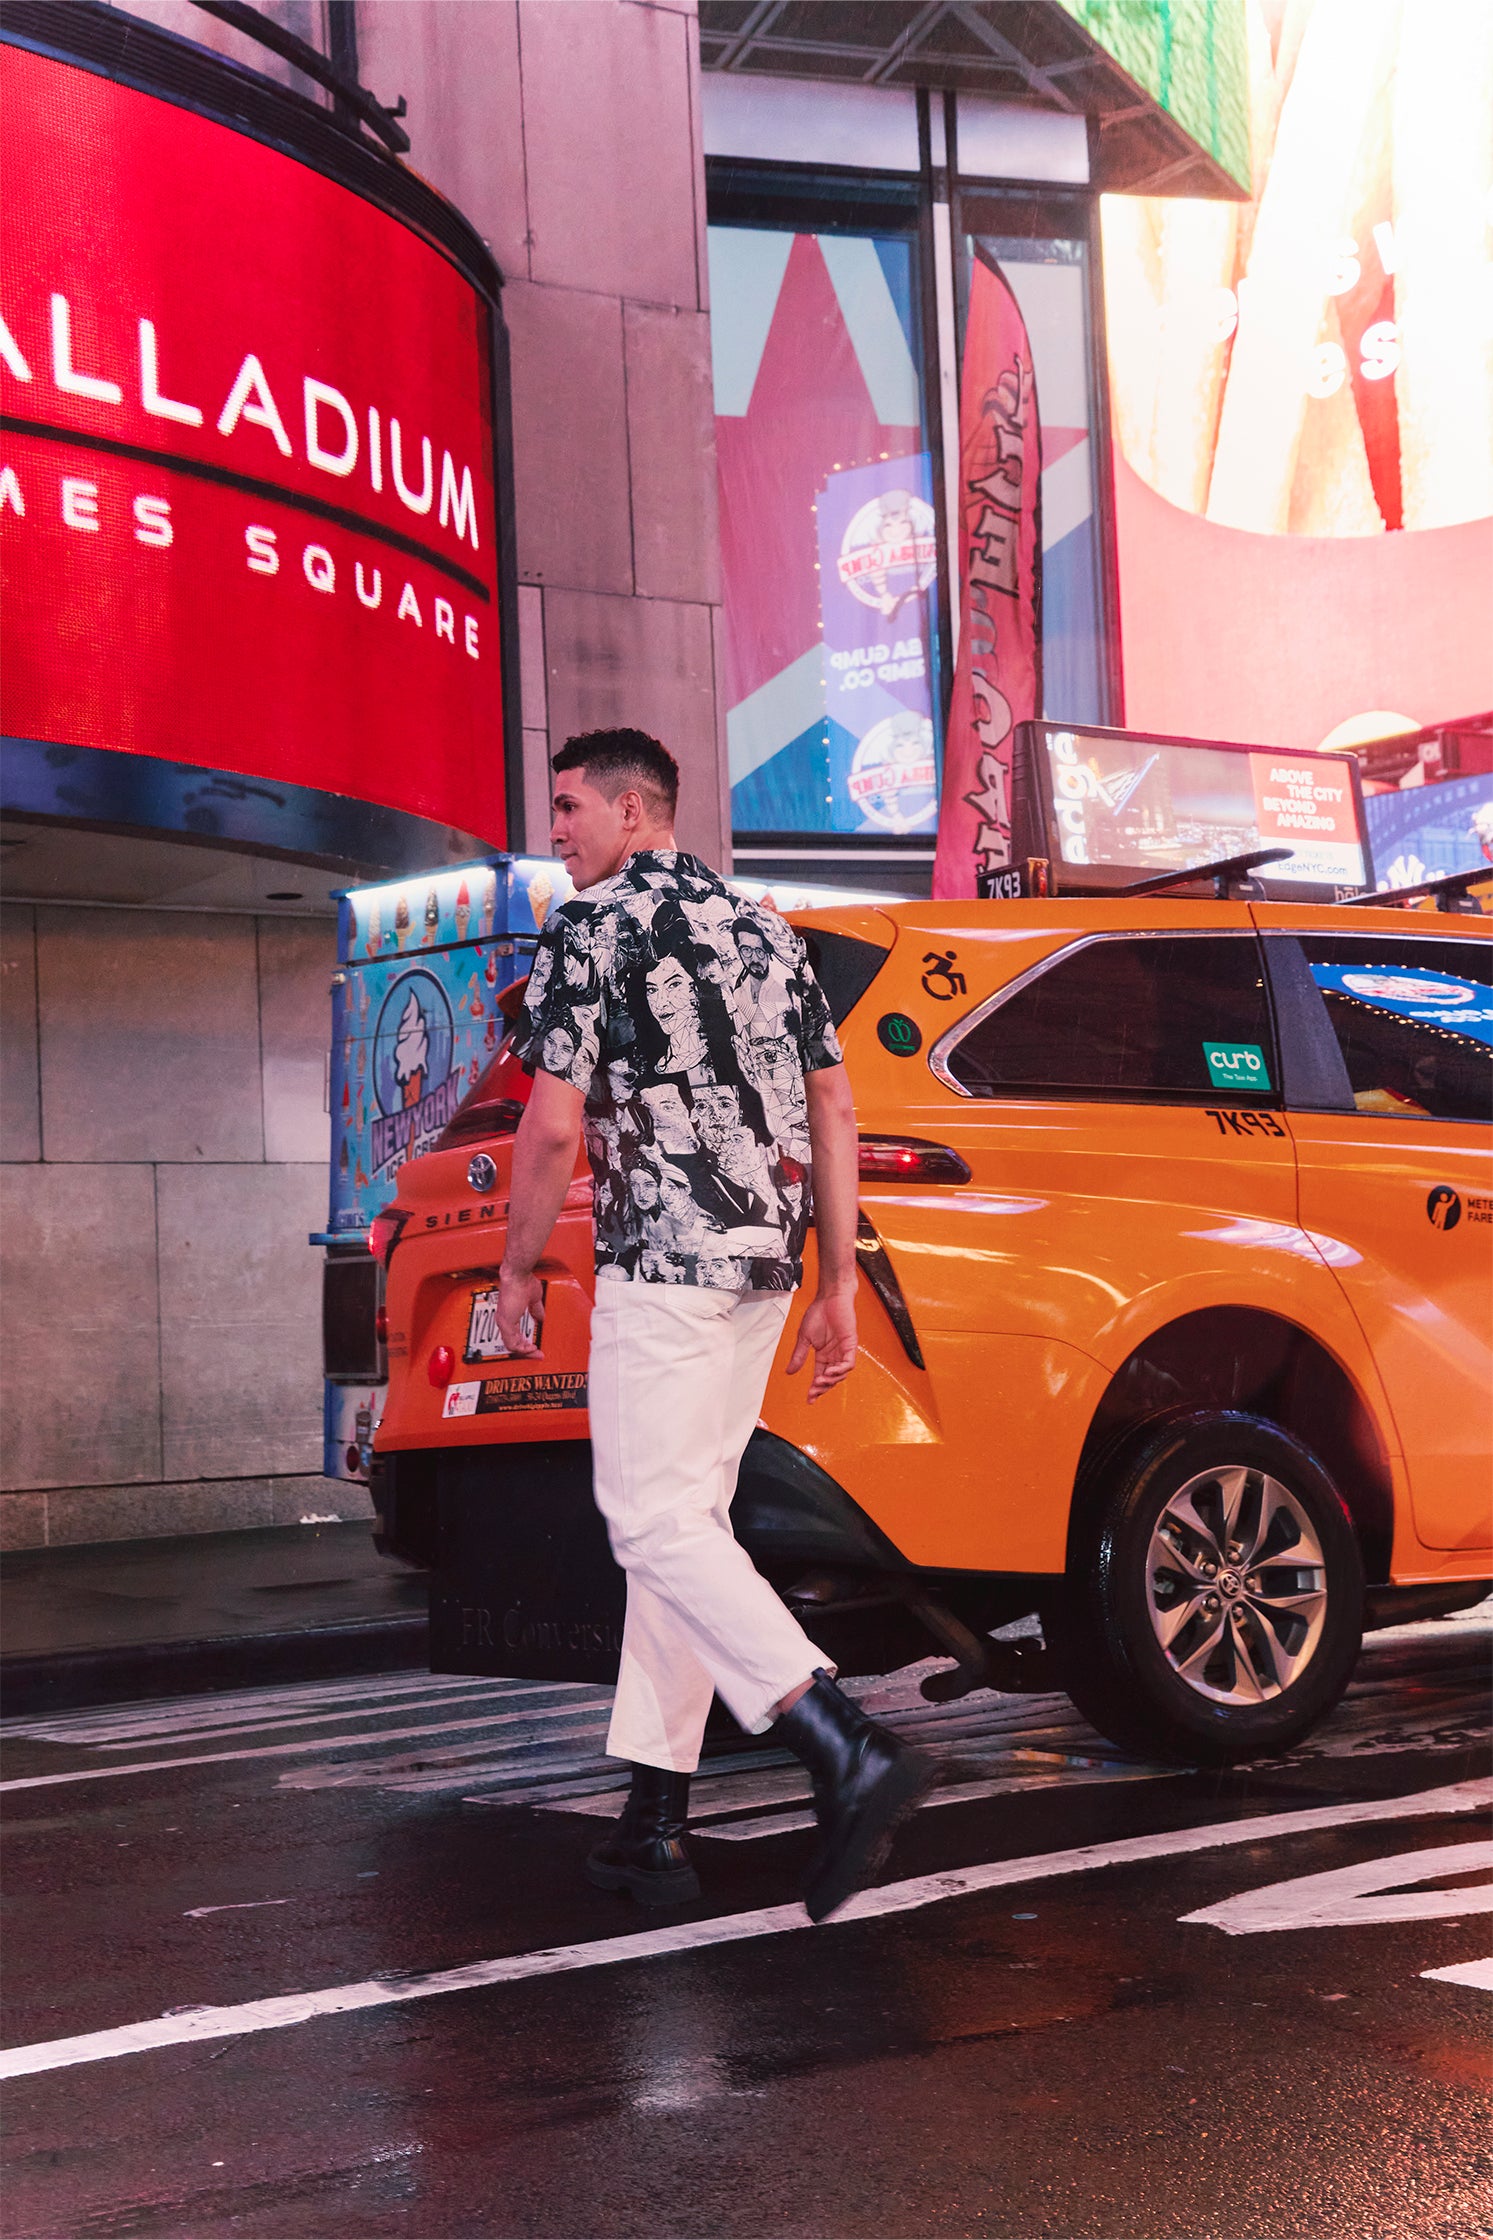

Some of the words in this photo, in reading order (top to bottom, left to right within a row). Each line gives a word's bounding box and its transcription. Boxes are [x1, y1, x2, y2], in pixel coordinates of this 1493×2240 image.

[244, 524, 481, 660] SQUARE
[1269, 768, 1314, 785] ABOVE
[1053, 732, 1098, 865] edge
[1286, 784, 1313, 800] THE
[1313, 787, 1343, 802] CITY
[1262, 796, 1317, 815] BEYOND
[1276, 813, 1336, 831] AMAZING
[986, 871, 1021, 899] 7K93
[1210, 1050, 1261, 1071] curb
[371, 1111, 412, 1176] NEW
[411, 1069, 461, 1141] YORK
[1205, 1110, 1286, 1137] 7K93
[1467, 1211, 1493, 1224] FARE
[484, 1376, 532, 1395] DRIVERS
